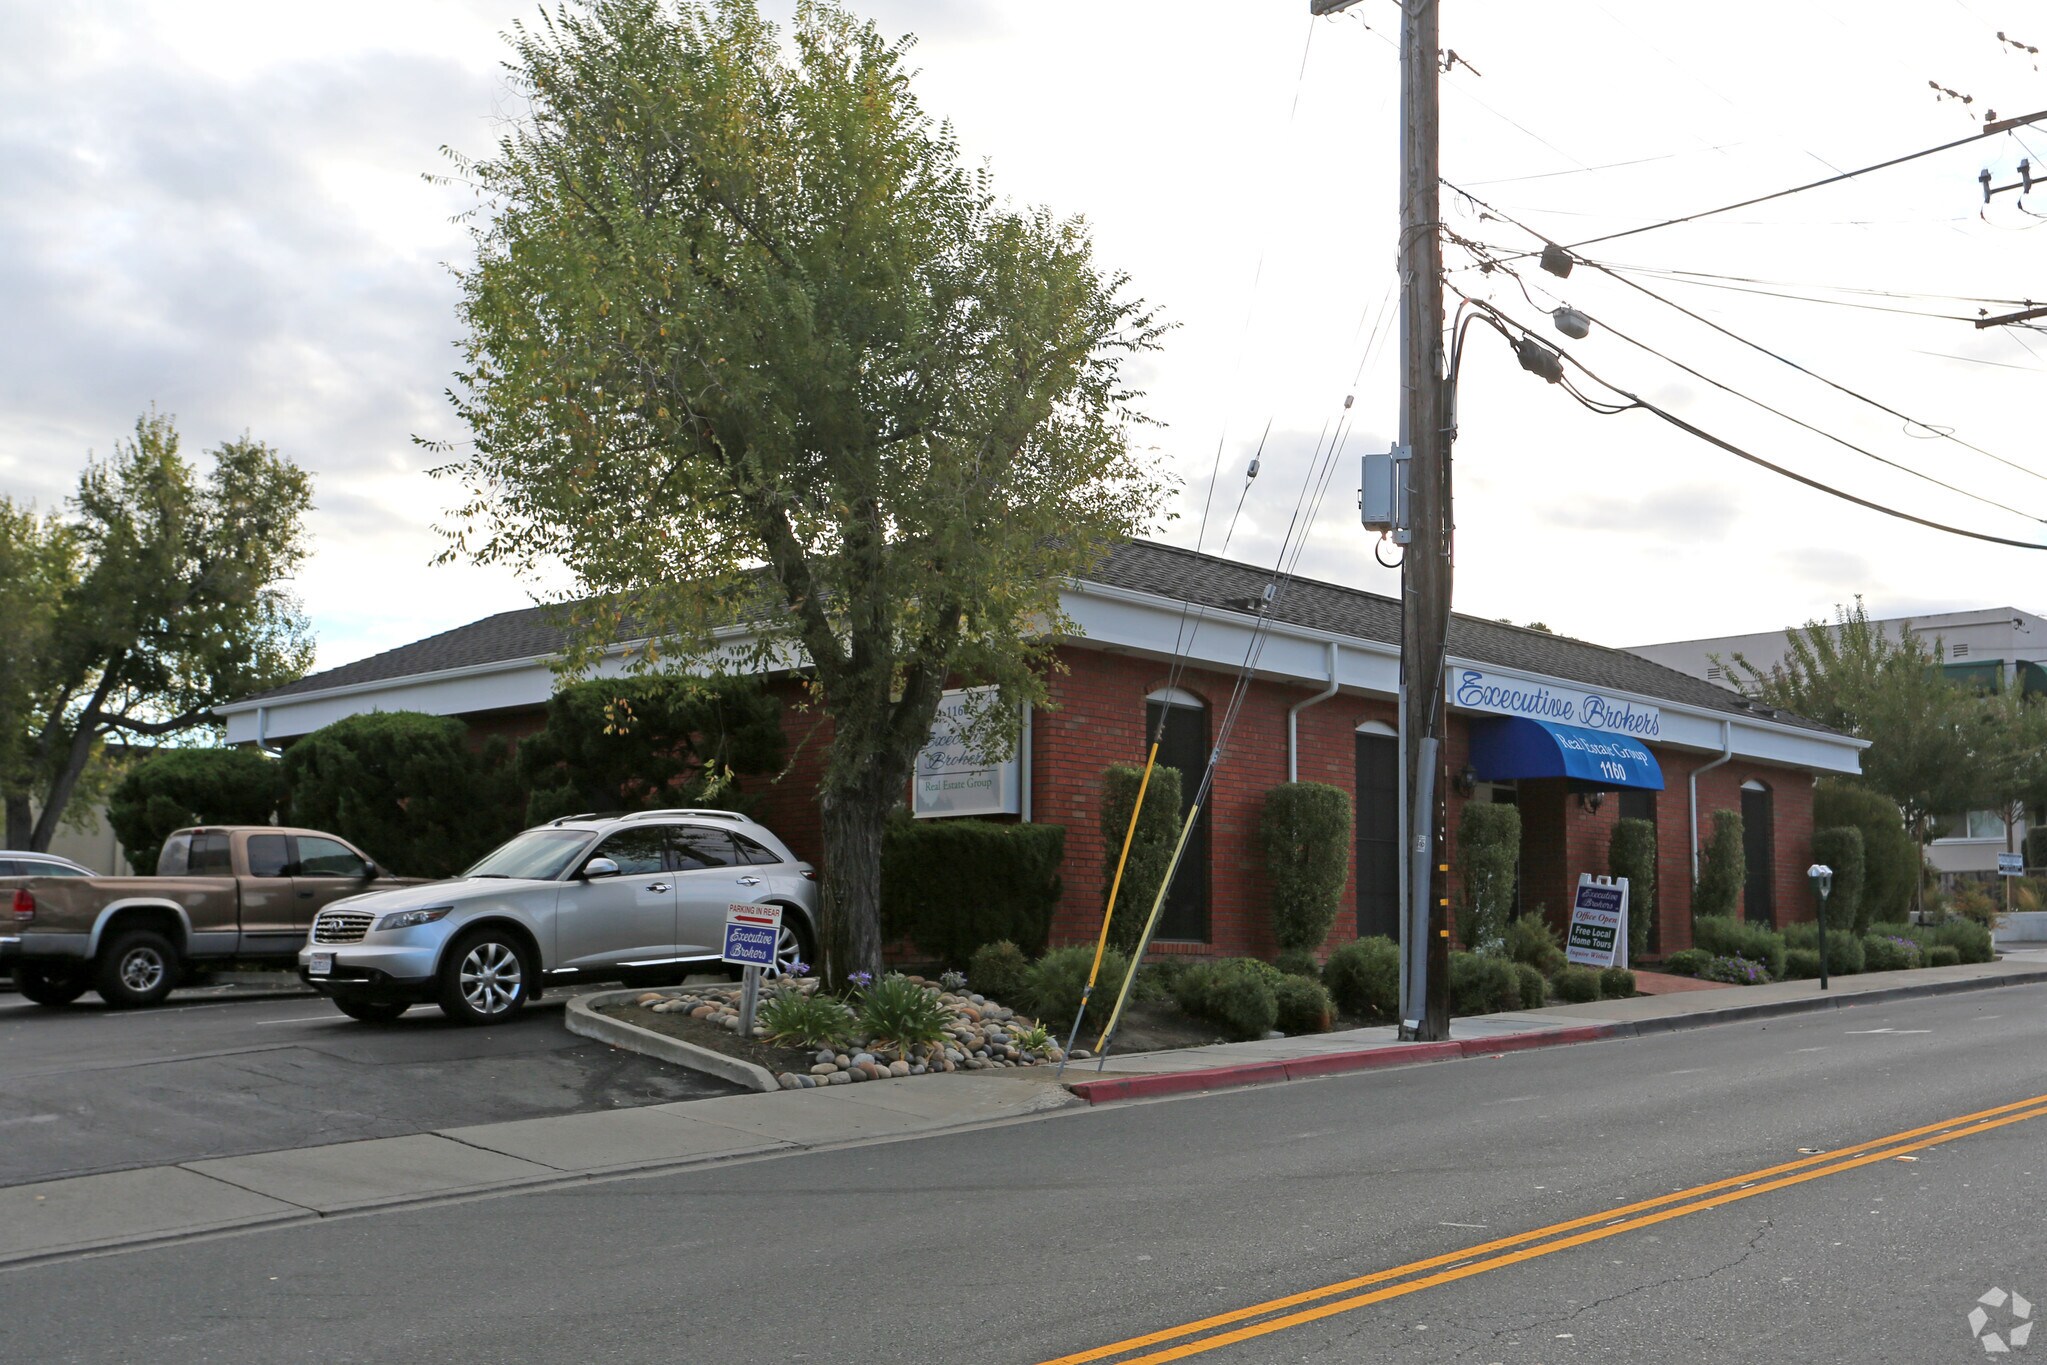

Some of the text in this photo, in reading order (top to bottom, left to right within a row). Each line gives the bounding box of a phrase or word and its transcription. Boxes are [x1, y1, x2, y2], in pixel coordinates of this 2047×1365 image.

[1457, 671, 1660, 736] Executive Brokers
[947, 704, 970, 718] 116
[1555, 733, 1648, 766] Real Estate Group
[1600, 761, 1627, 781] 1160
[925, 777, 992, 792] Real Estate Group
[1582, 888, 1619, 901] Executive
[729, 904, 780, 917] PARKING IN REAR
[1582, 898, 1614, 910] Brokers
[1575, 910, 1618, 924] Office Open
[730, 928, 773, 945] Executive
[1575, 925, 1612, 939] Free Local
[1571, 935, 1612, 949] Home Tours
[730, 943, 767, 960] Brokers
